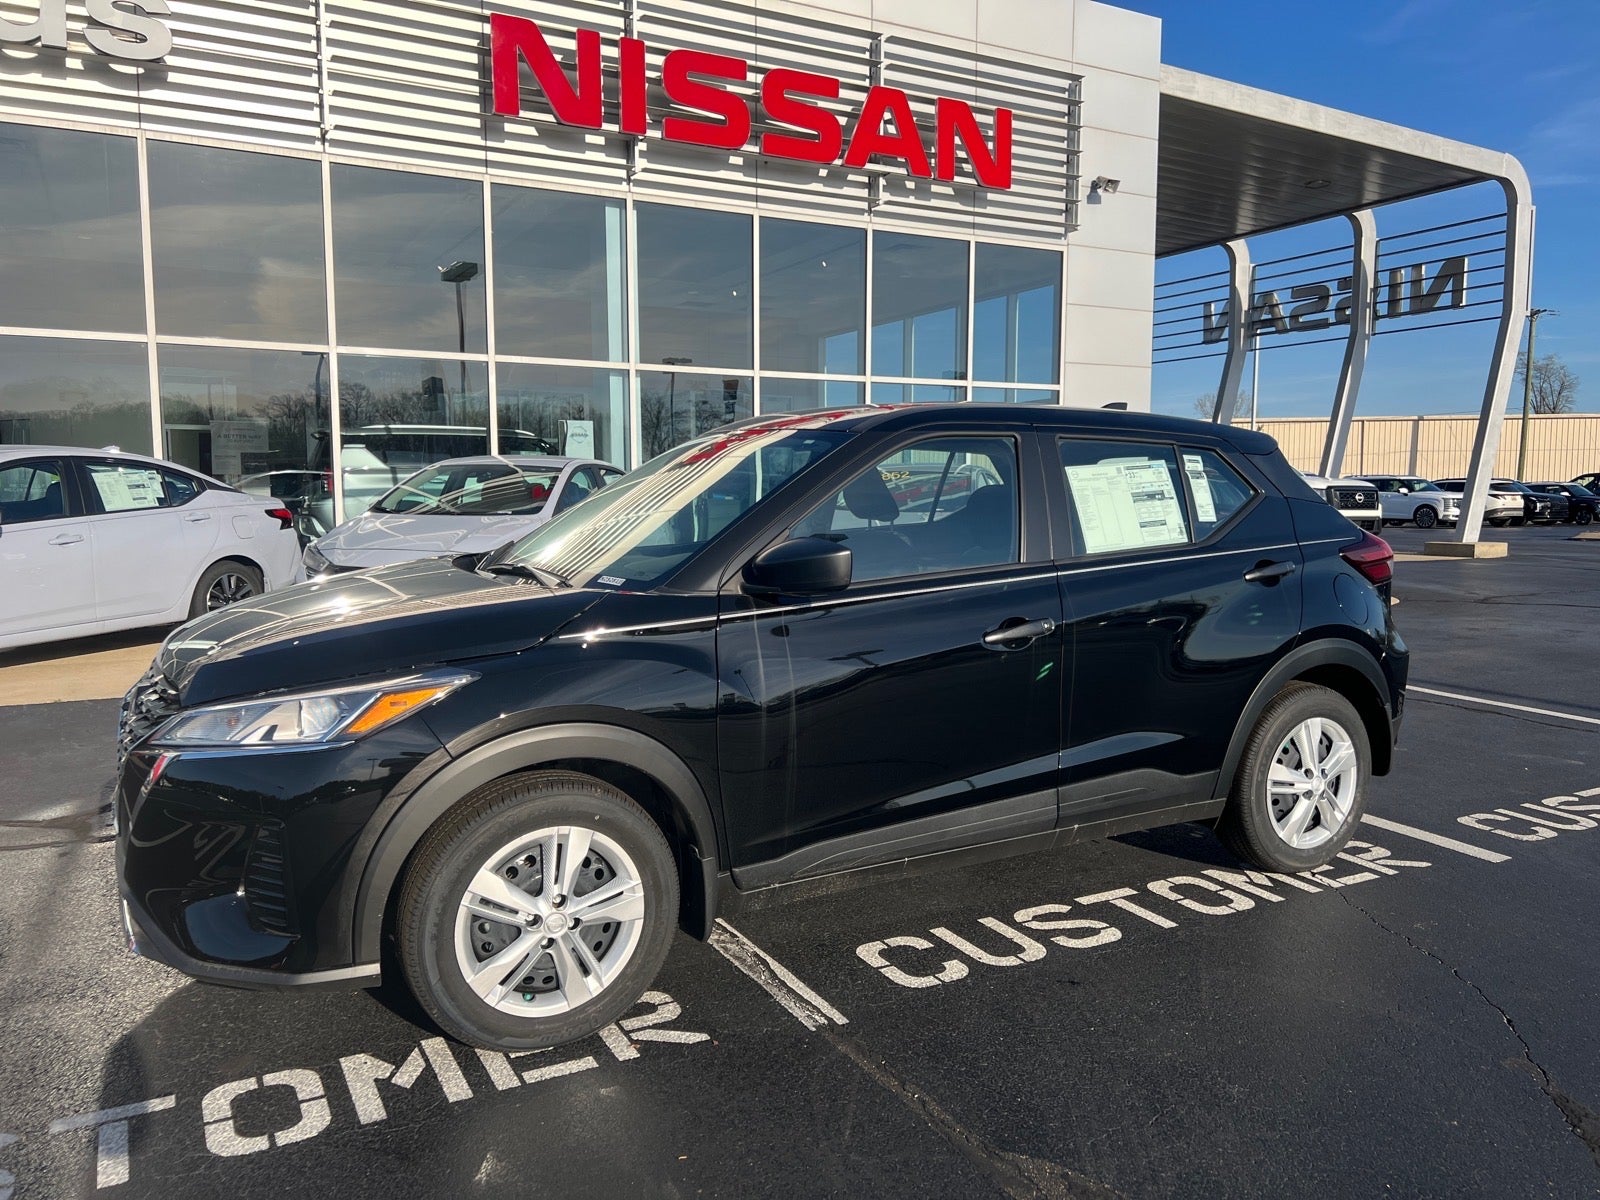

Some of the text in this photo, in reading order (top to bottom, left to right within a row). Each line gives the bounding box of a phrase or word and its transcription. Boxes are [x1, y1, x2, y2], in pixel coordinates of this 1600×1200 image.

[490, 13, 1012, 190] NISSAN
[855, 840, 1432, 989] CUSTOMER
[0, 991, 711, 1200] TOMER
